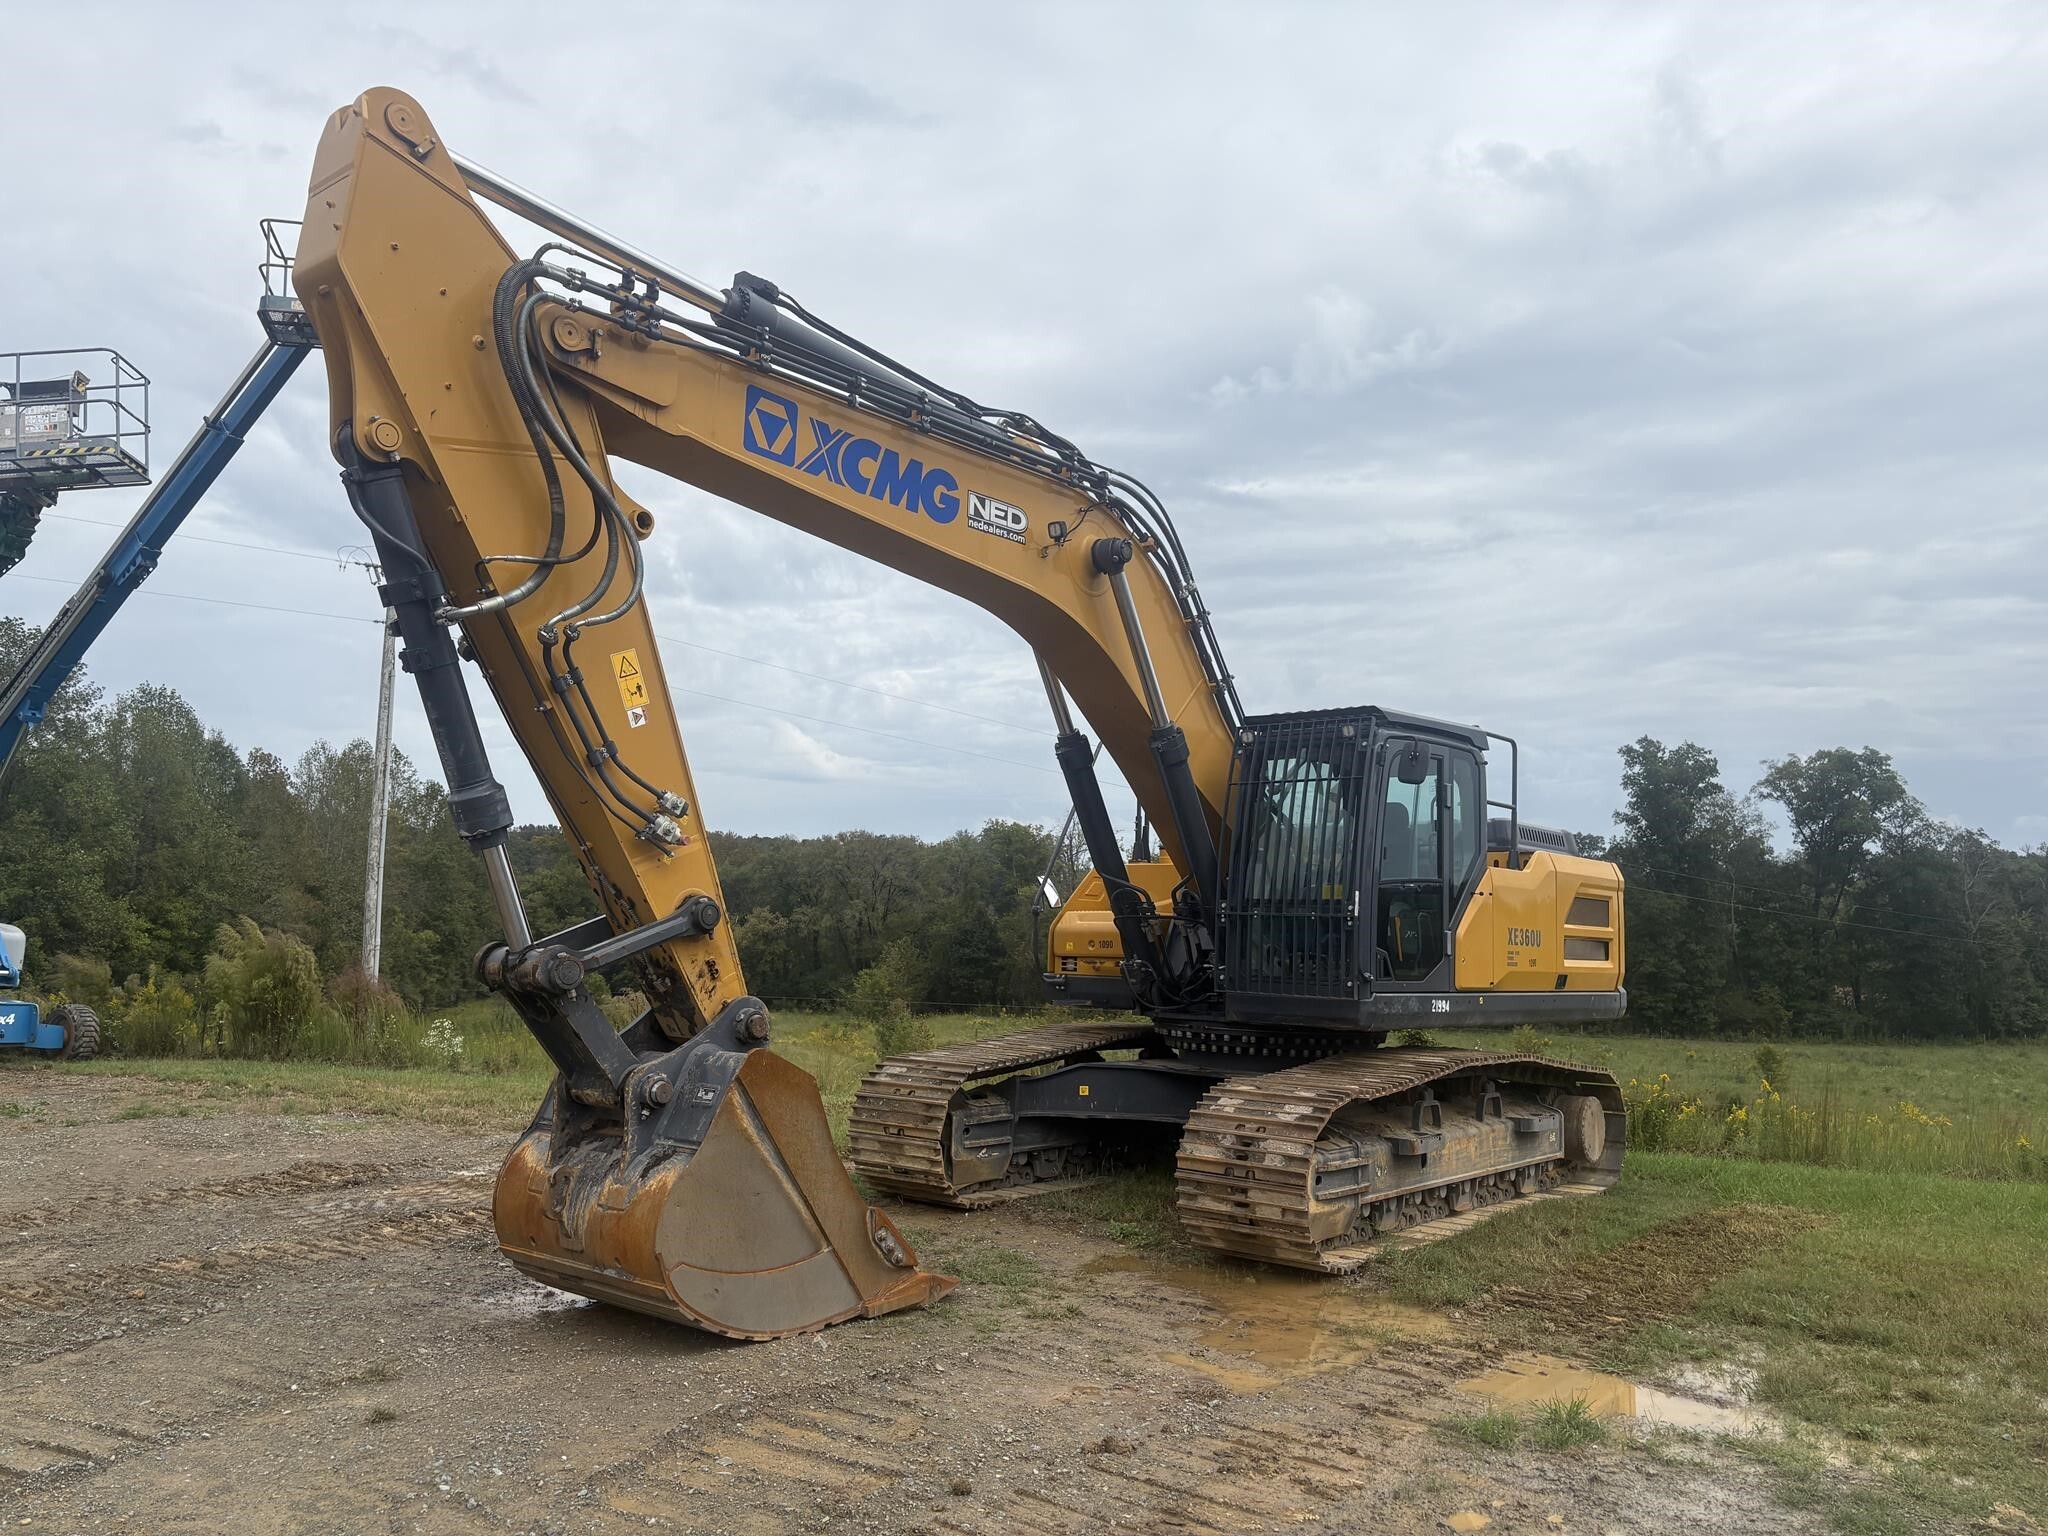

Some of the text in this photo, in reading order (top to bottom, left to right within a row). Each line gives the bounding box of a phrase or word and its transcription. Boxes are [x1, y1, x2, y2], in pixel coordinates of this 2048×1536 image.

[795, 416, 961, 524] XCMG
[969, 494, 1027, 531] NED
[968, 519, 1026, 544] nedealers.com
[1507, 927, 1541, 948] XE360U
